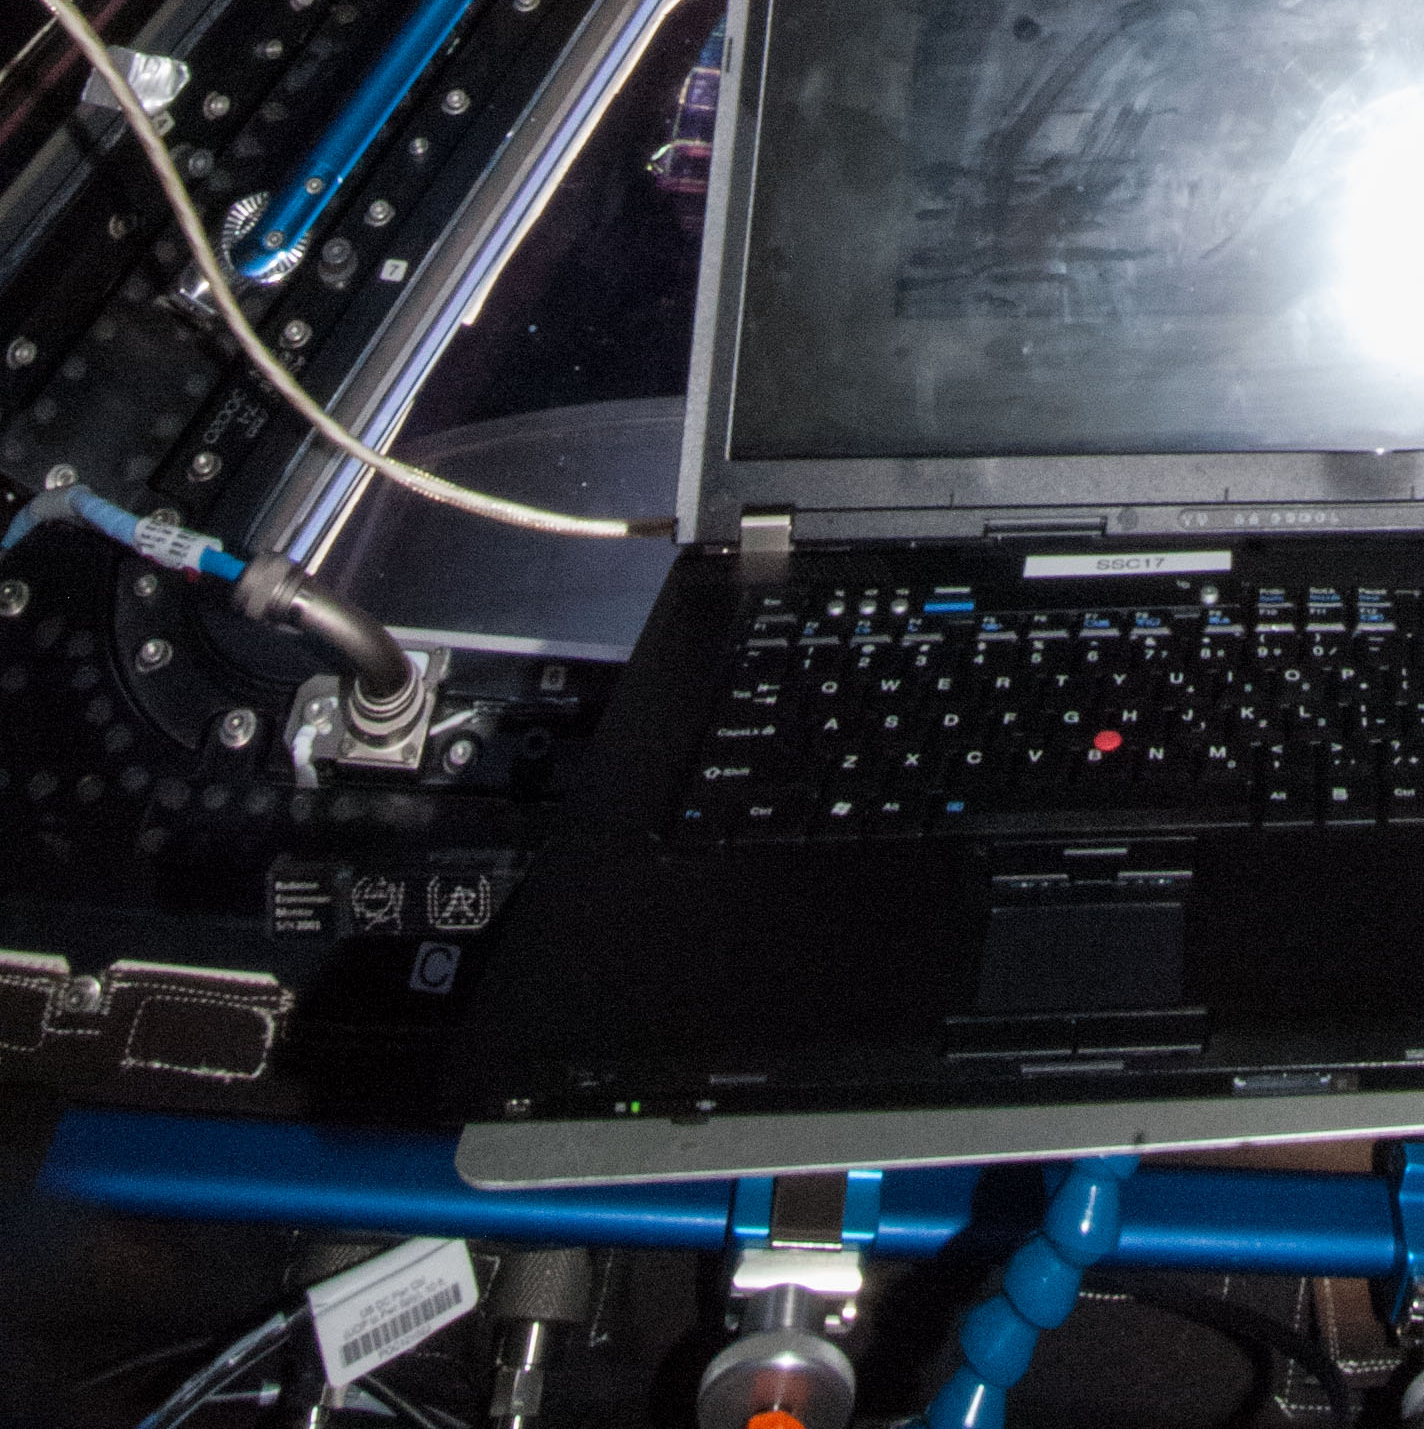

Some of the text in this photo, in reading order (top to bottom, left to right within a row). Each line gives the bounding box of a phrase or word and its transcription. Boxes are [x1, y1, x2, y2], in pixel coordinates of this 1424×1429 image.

[390, 262, 405, 282] 7
[1095, 557, 1166, 572] SSC17
[1113, 673, 1127, 685] Y
[1169, 672, 1184, 684] U
[1227, 671, 1234, 683] I
[1284, 669, 1301, 681] O
[1341, 668, 1356, 680] P
[880, 679, 902, 692] W
[936, 677, 952, 690] E
[995, 677, 1012, 689] R
[1056, 675, 1070, 687] T
[821, 681, 838, 695] Q
[1063, 711, 1080, 723] G
[1122, 709, 1138, 722] H
[1182, 709, 1194, 721] J
[1240, 707, 1254, 719] K
[1298, 705, 1311, 718] L
[823, 717, 840, 731] A
[884, 715, 899, 728] S
[943, 713, 960, 727] D
[1002, 712, 1017, 725] F
[966, 751, 983, 765] C
[1028, 749, 1044, 763] V
[1087, 749, 1102, 761] B
[1148, 747, 1164, 760] N
[1208, 746, 1227, 759] M
[842, 754, 859, 768] Z
[904, 753, 920, 766] X
[424, 950, 451, 985] C
